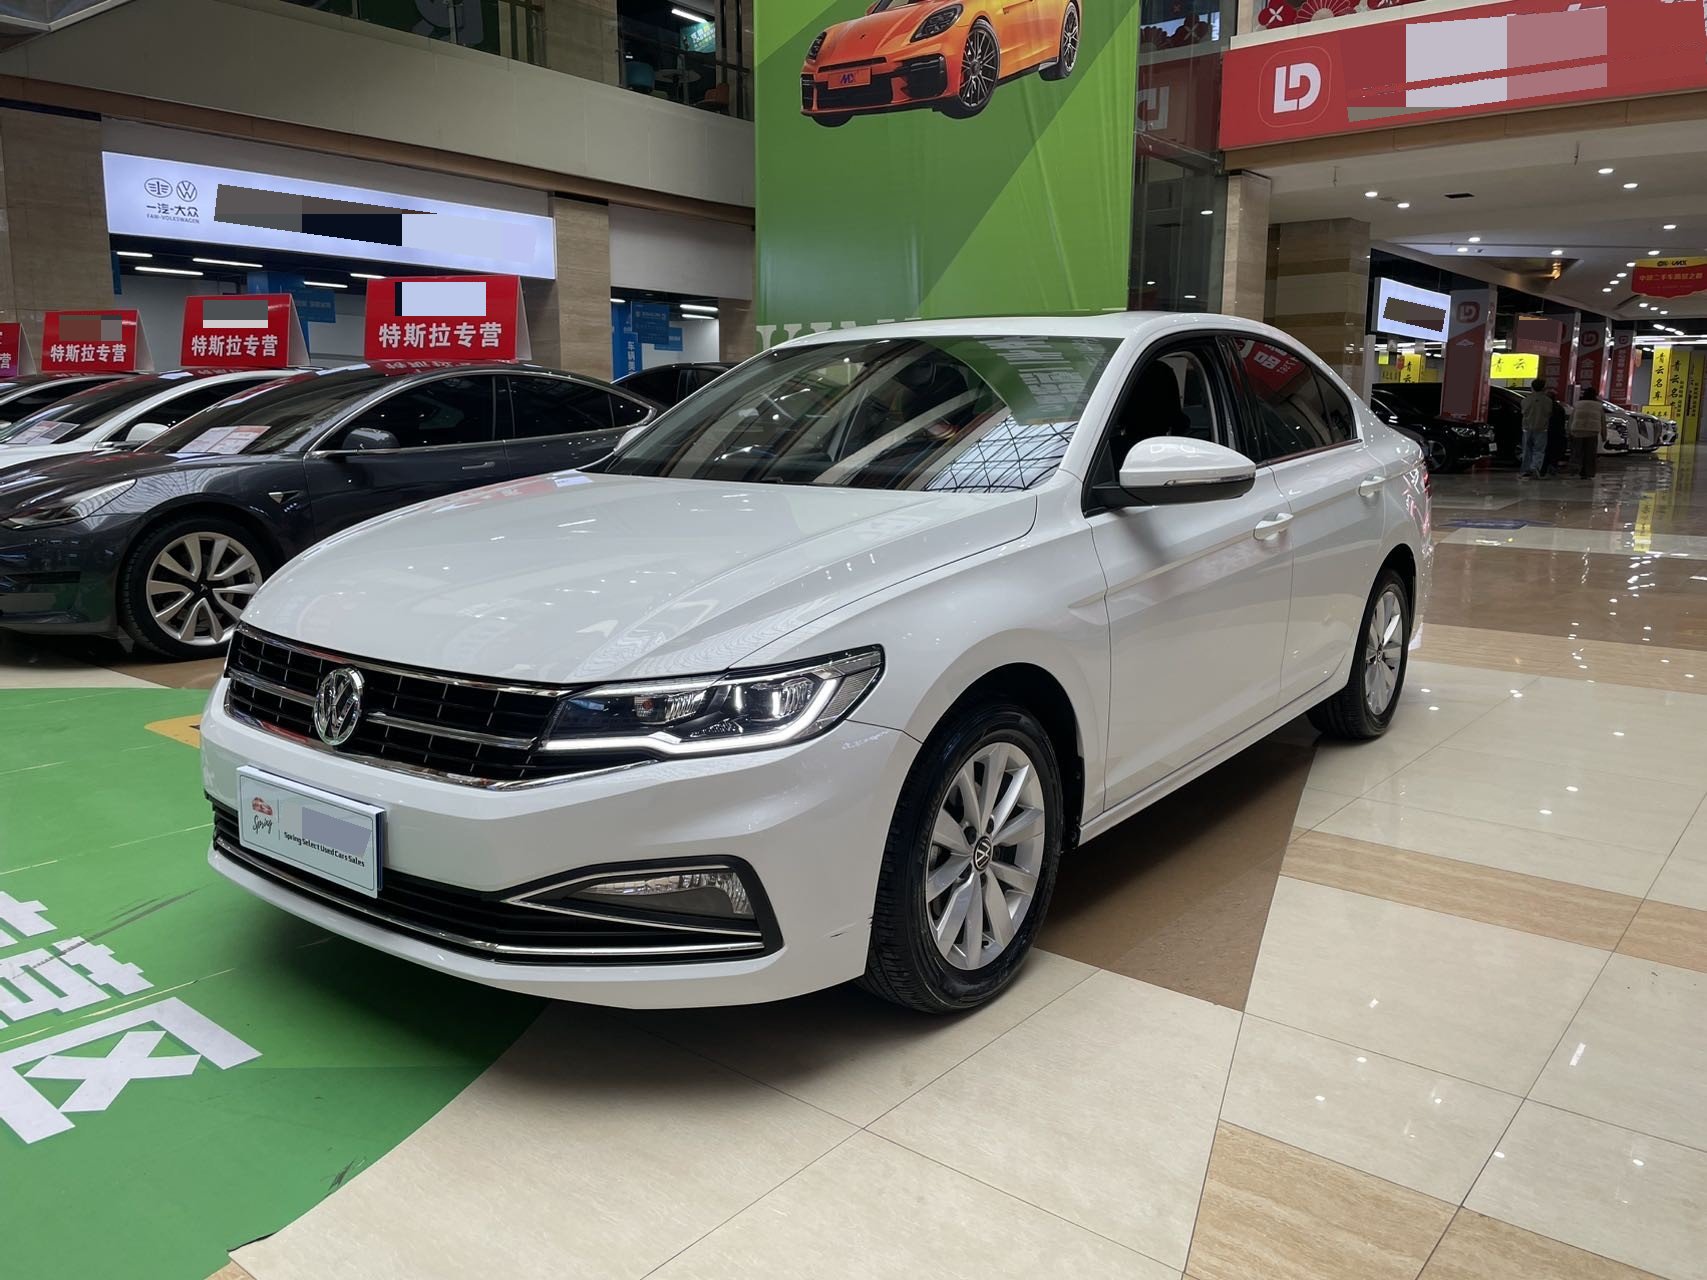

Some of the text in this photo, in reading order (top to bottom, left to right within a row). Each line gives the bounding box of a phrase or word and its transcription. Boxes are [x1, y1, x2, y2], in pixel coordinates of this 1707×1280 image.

[1273, 62, 1322, 114] LD
[191, 334, 278, 357] 特斯拉专营
[378, 321, 502, 348] 特斯拉专营
[50, 343, 126, 363] 特斯拉专营
[253, 815, 273, 834] Spring
[284, 831, 365, 868] Spring Select Used Cars Sales
